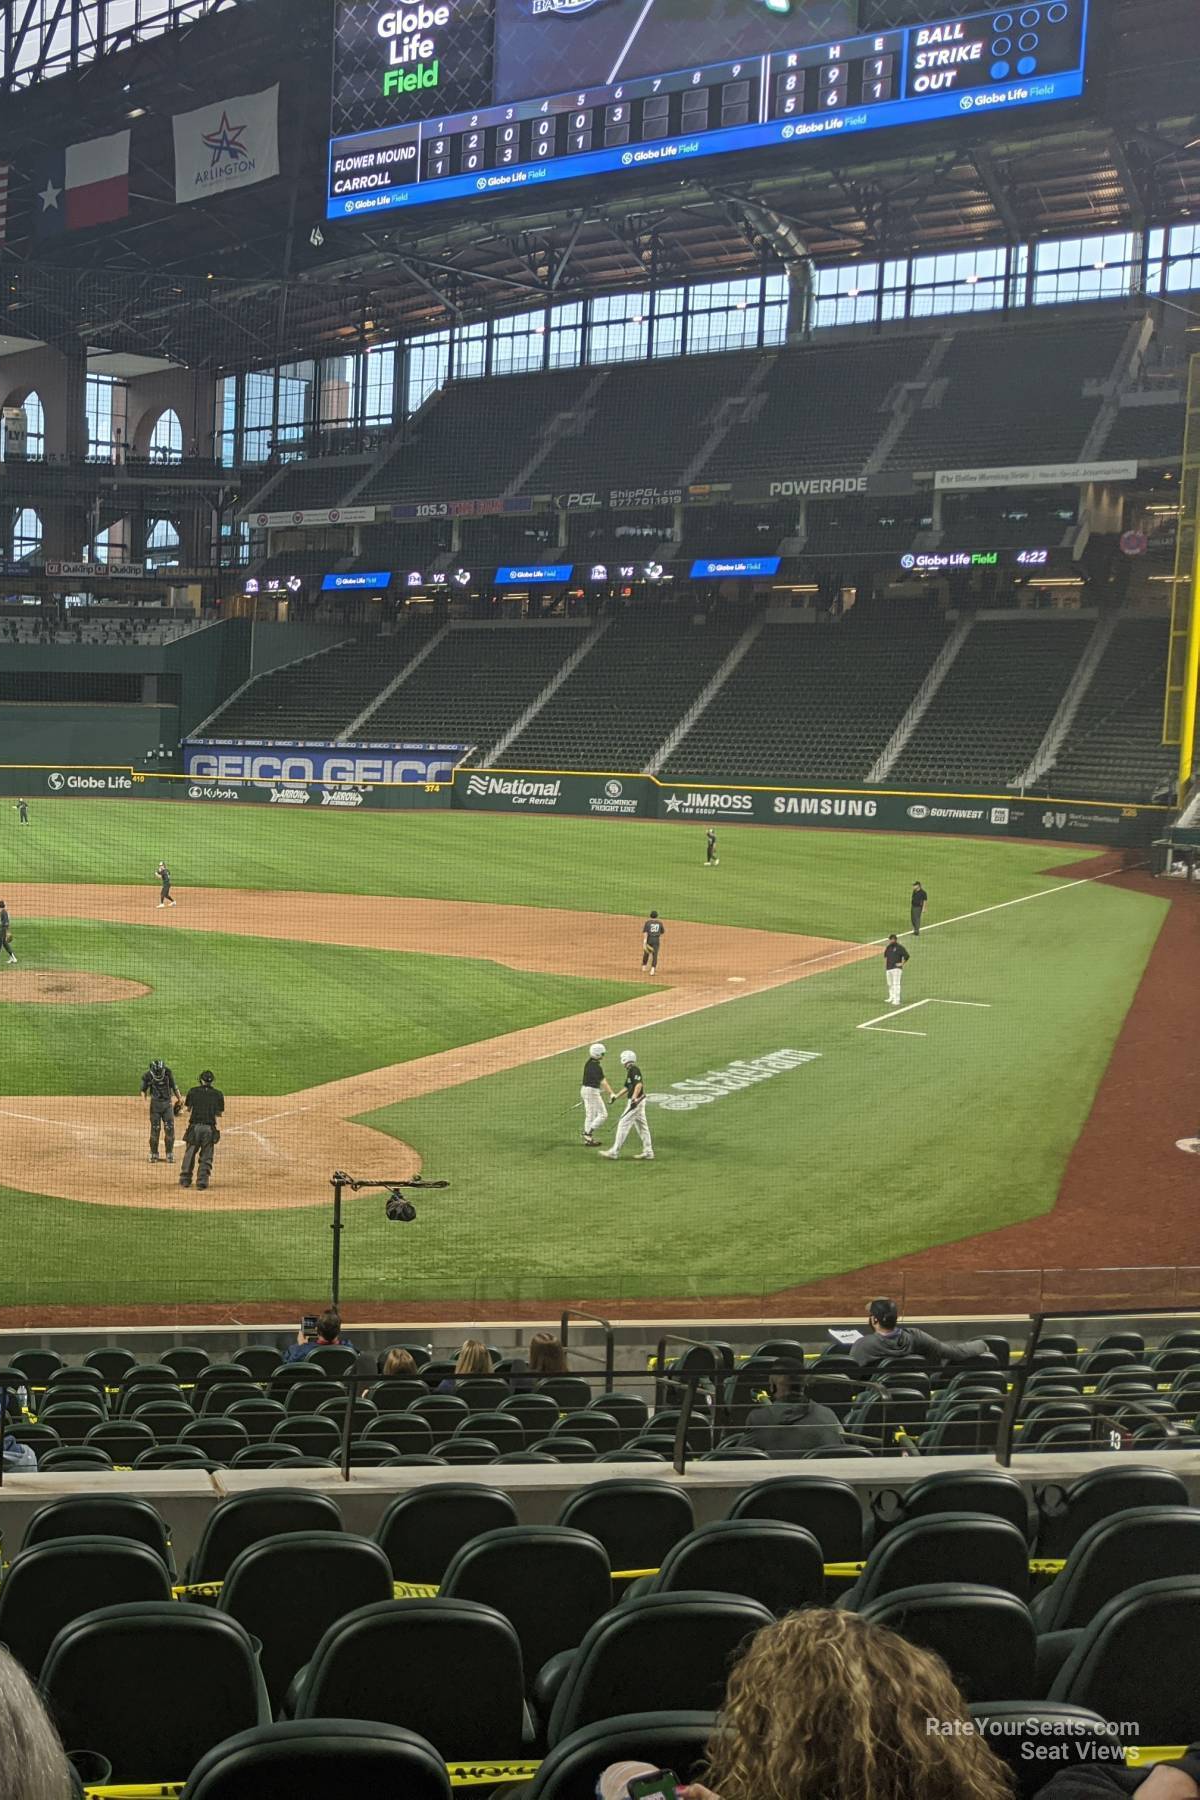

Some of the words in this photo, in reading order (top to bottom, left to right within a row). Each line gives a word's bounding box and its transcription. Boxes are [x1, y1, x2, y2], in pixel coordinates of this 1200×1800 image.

[377, 6, 449, 38] Globe
[916, 23, 965, 46] BALL
[389, 33, 434, 65] Life
[914, 43, 983, 69] STRIKE
[383, 60, 438, 96] Field
[437, 122, 444, 133] 1
[469, 115, 478, 127] 2
[505, 108, 513, 120] 3
[540, 101, 549, 113] 4
[577, 94, 585, 106] 5
[614, 87, 623, 99] 6
[653, 79, 661, 92] 7
[692, 72, 701, 84] 8
[731, 65, 741, 77] 9
[787, 54, 797, 67] R
[829, 46, 840, 59] H
[874, 38, 884, 51] E
[914, 70, 957, 92] OUT
[974, 93, 1006, 107] Globe
[1007, 89, 1028, 102] Life
[1029, 84, 1054, 98] Field
[334, 154, 375, 173] FLOWER
[376, 146, 416, 164] MOUND
[434, 142, 444, 154] 3
[469, 136, 478, 148] 2
[504, 128, 514, 141] 0
[539, 122, 549, 135] 0
[575, 115, 585, 128] 0
[613, 108, 622, 121] 3
[785, 76, 796, 90] 8
[828, 68, 840, 83] 9
[874, 60, 883, 76] 1
[795, 122, 824, 135] Globe
[825, 118, 843, 131] Life
[845, 114, 867, 127] Field
[334, 172, 391, 193] CARROLL
[435, 161, 443, 174] 1
[468, 155, 478, 168] 0
[503, 149, 513, 162] 3
[538, 142, 548, 156] 0
[576, 136, 584, 149] 1
[784, 98, 796, 113] 5
[827, 91, 838, 106] 6
[873, 83, 883, 98] 1
[634, 149, 660, 162] Globe
[661, 146, 677, 158] Life
[678, 142, 699, 155] Field
[195, 159, 256, 185] ARLINGTON
[488, 175, 511, 187] Globe
[512, 172, 527, 183] Life
[528, 168, 547, 181] Field
[355, 198, 376, 210] Globe
[377, 196, 391, 207] Life
[391, 192, 409, 203] Field
[769, 477, 868, 497] POWERADE
[567, 492, 602, 506] PGL
[416, 503, 448, 517] 105.3
[916, 555, 948, 566] Globe
[949, 553, 970, 565] Life
[971, 553, 998, 564] Field
[1016, 550, 1048, 563] 4:22
[62, 563, 95, 575] QuikTrip
[109, 563, 142, 575] QuikTrip
[533, 570, 543, 578] Life
[620, 567, 634, 577] VS
[716, 564, 734, 572] Globe
[734, 563, 746, 571] Life
[267, 580, 280, 589] VS
[432, 573, 446, 583] VS
[132, 775, 145, 783] 410
[189, 755, 314, 788] GEICO
[66, 776, 106, 789] Globe
[107, 775, 132, 789] Life
[424, 784, 440, 793] 374
[203, 786, 239, 800] Kubota
[280, 789, 304, 799] ARROW
[331, 791, 357, 801] ARROW
[512, 796, 527, 804] Car
[528, 797, 557, 806] Rental
[591, 804, 618, 812] FREIGHT
[619, 805, 636, 813] LINE
[604, 798, 638, 806] DOMINION
[773, 796, 877, 817] SAMSUNG
[930, 808, 984, 819] SOUTHWEST
[1110, 1430, 1121, 1450] 13
